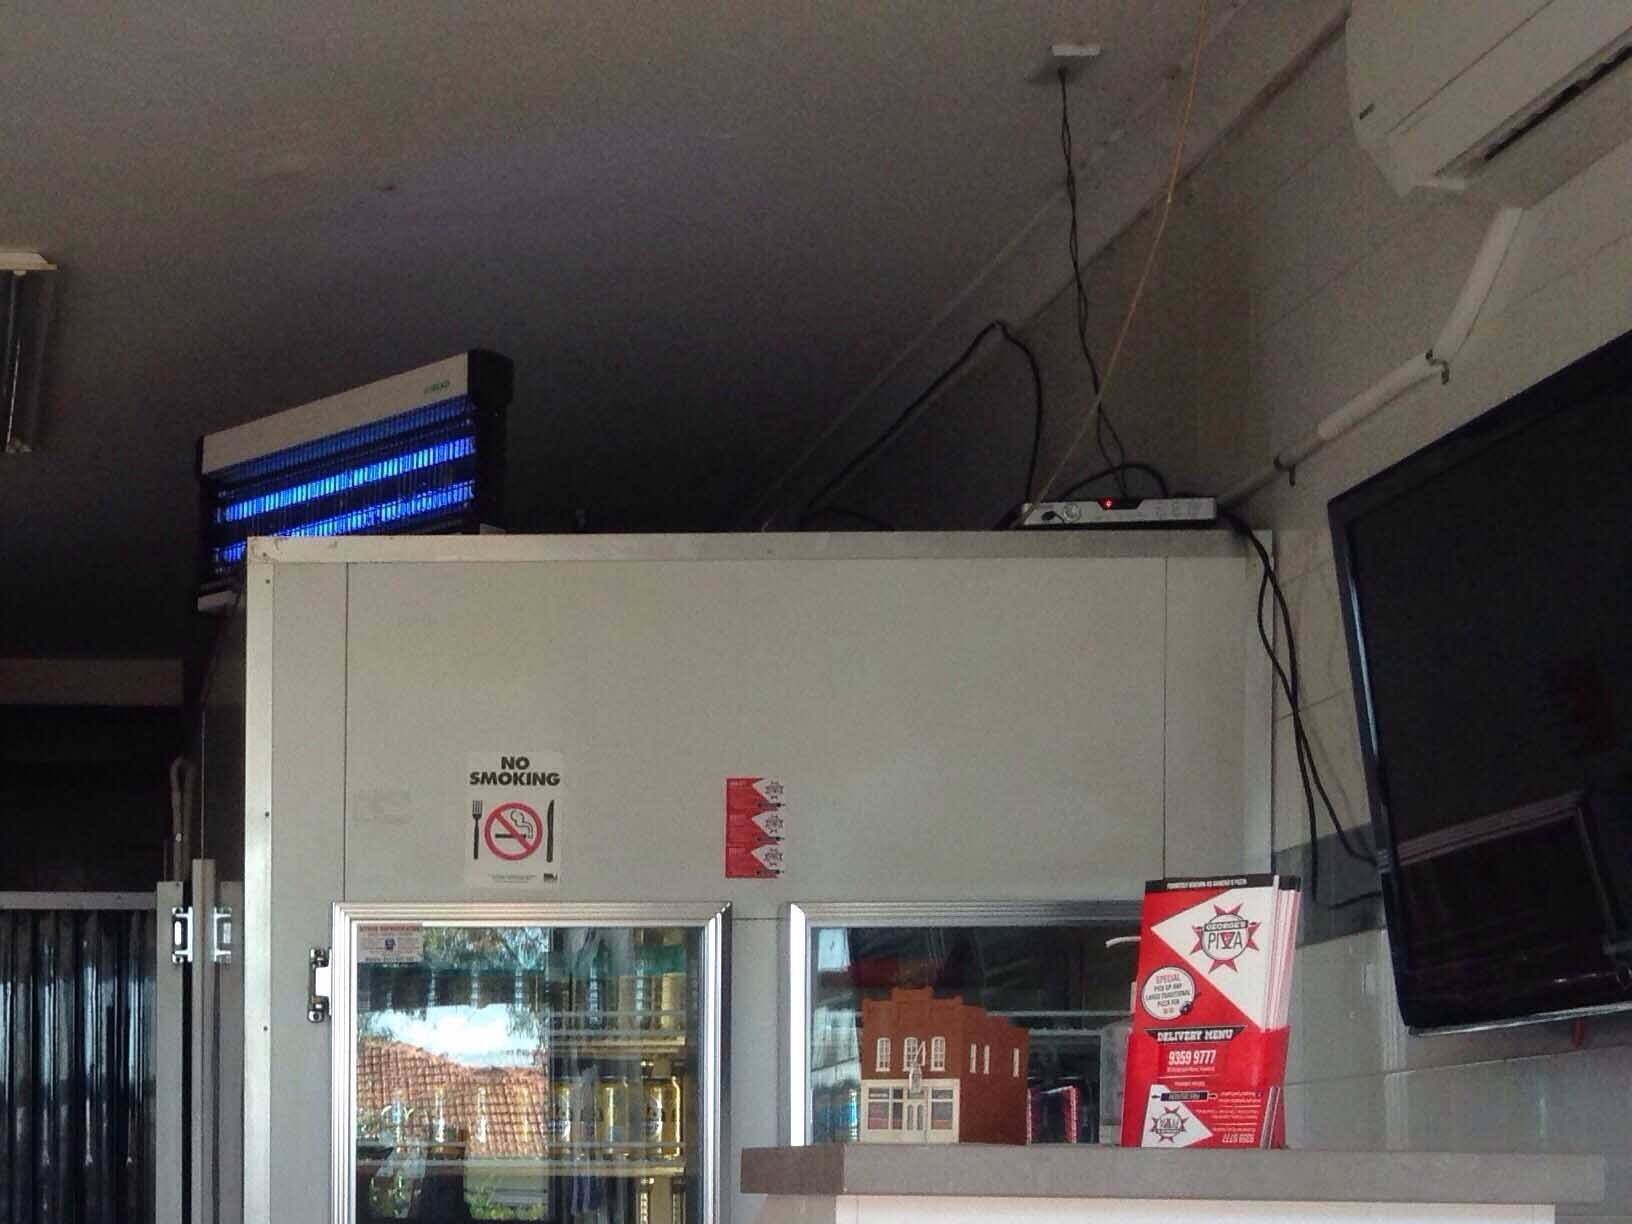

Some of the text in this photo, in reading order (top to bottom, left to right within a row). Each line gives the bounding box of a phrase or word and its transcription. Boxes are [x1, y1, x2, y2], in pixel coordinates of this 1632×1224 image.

[500, 756, 530, 770] NO
[469, 771, 561, 786] SMOKING
[1157, 1029, 1234, 1042] DELIVERY MENU
[1168, 1049, 1216, 1066] 9359 9777
